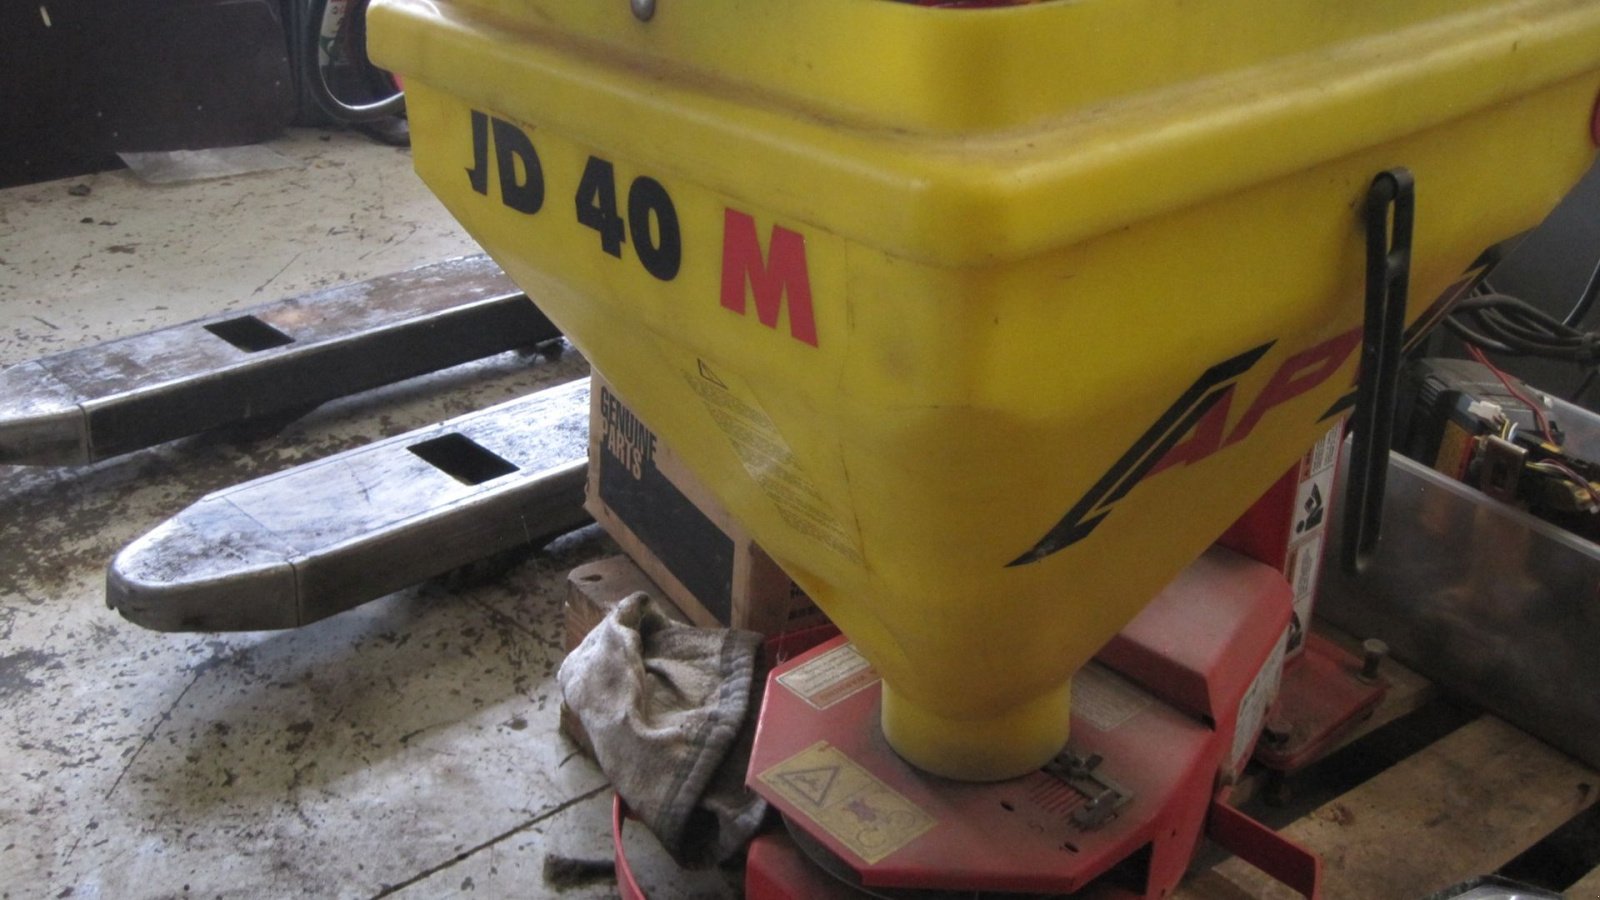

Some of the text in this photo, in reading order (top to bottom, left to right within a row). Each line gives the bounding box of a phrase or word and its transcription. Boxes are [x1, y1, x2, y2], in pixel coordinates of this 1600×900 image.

[465, 109, 819, 349] JD 40 M
[601, 385, 657, 462] GENUINE
[602, 417, 642, 481] PARTS
